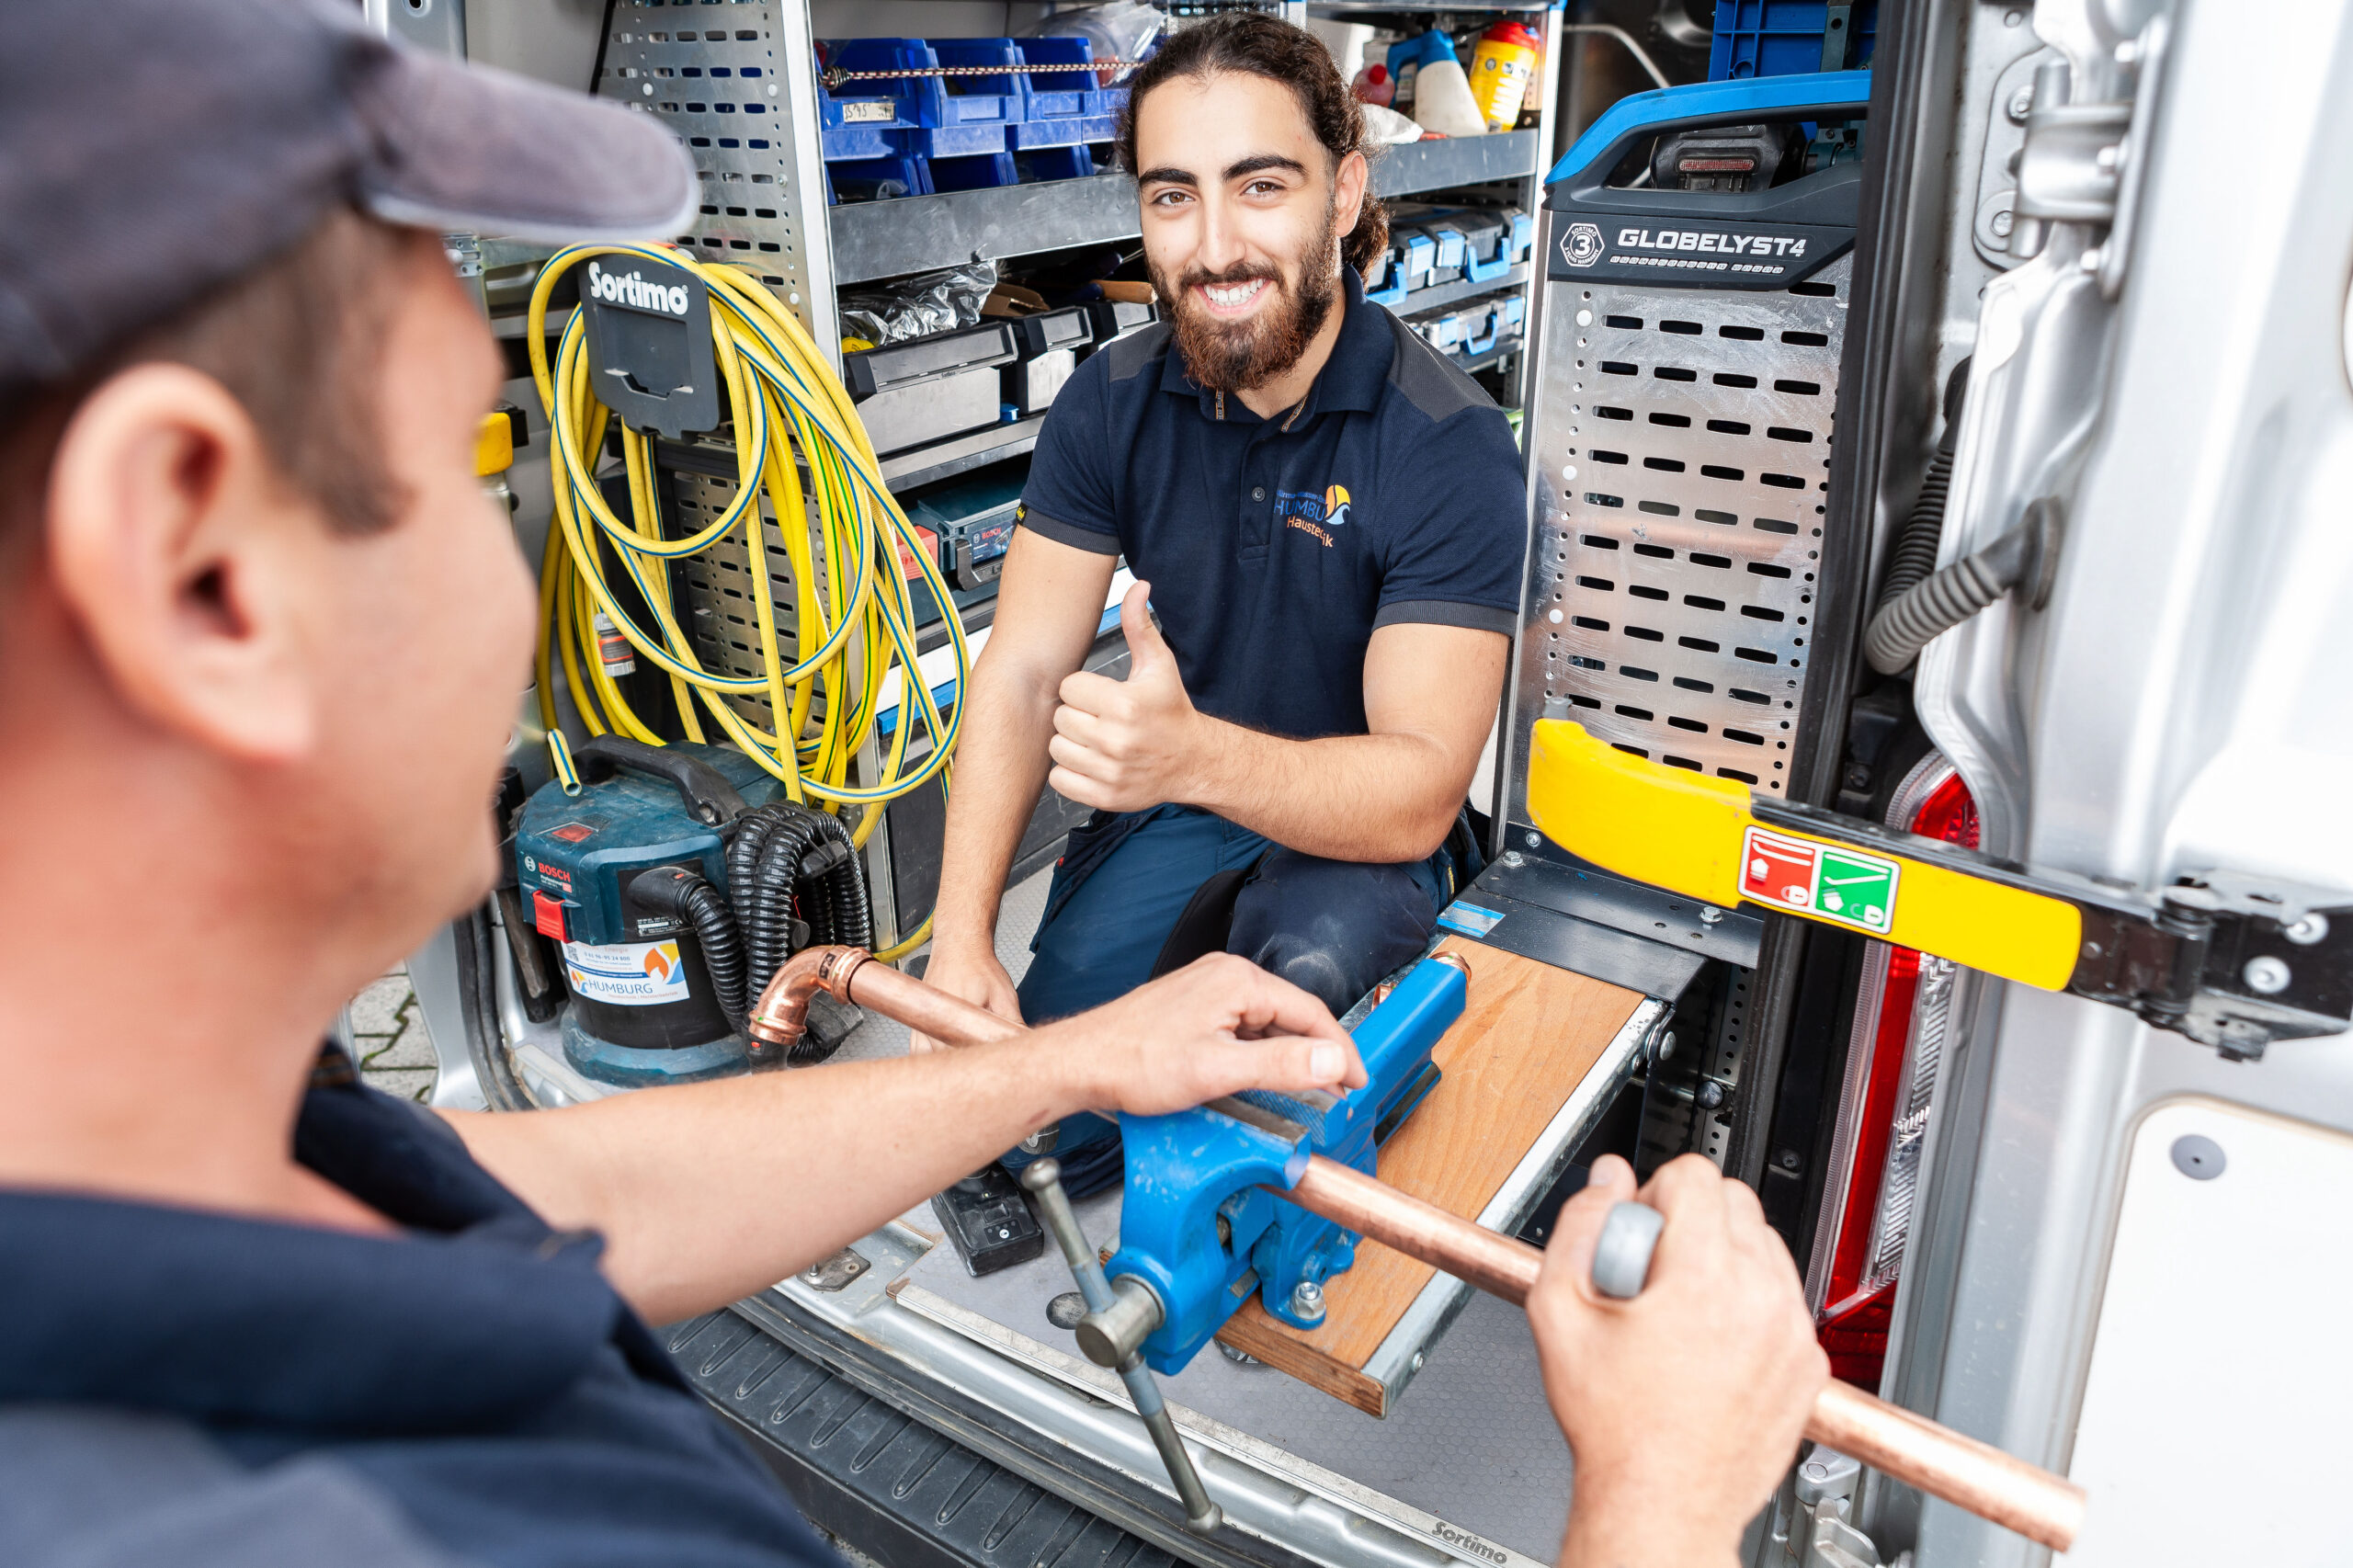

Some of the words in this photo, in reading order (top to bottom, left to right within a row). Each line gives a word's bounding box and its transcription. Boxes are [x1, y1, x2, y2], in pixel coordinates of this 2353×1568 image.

[1571, 226, 1597, 236] SORTIMO
[1574, 234, 1591, 256] 3
[1618, 229, 1807, 257] GLOBELYST4
[1274, 499, 1325, 522] HUMBU
[982, 528, 1002, 540] BOSCH
[1287, 516, 1334, 548] Haustecik
[539, 862, 571, 883] BOSCH
[589, 979, 653, 994] HUMBURG
[1432, 1521, 1506, 1563] Sortimo
